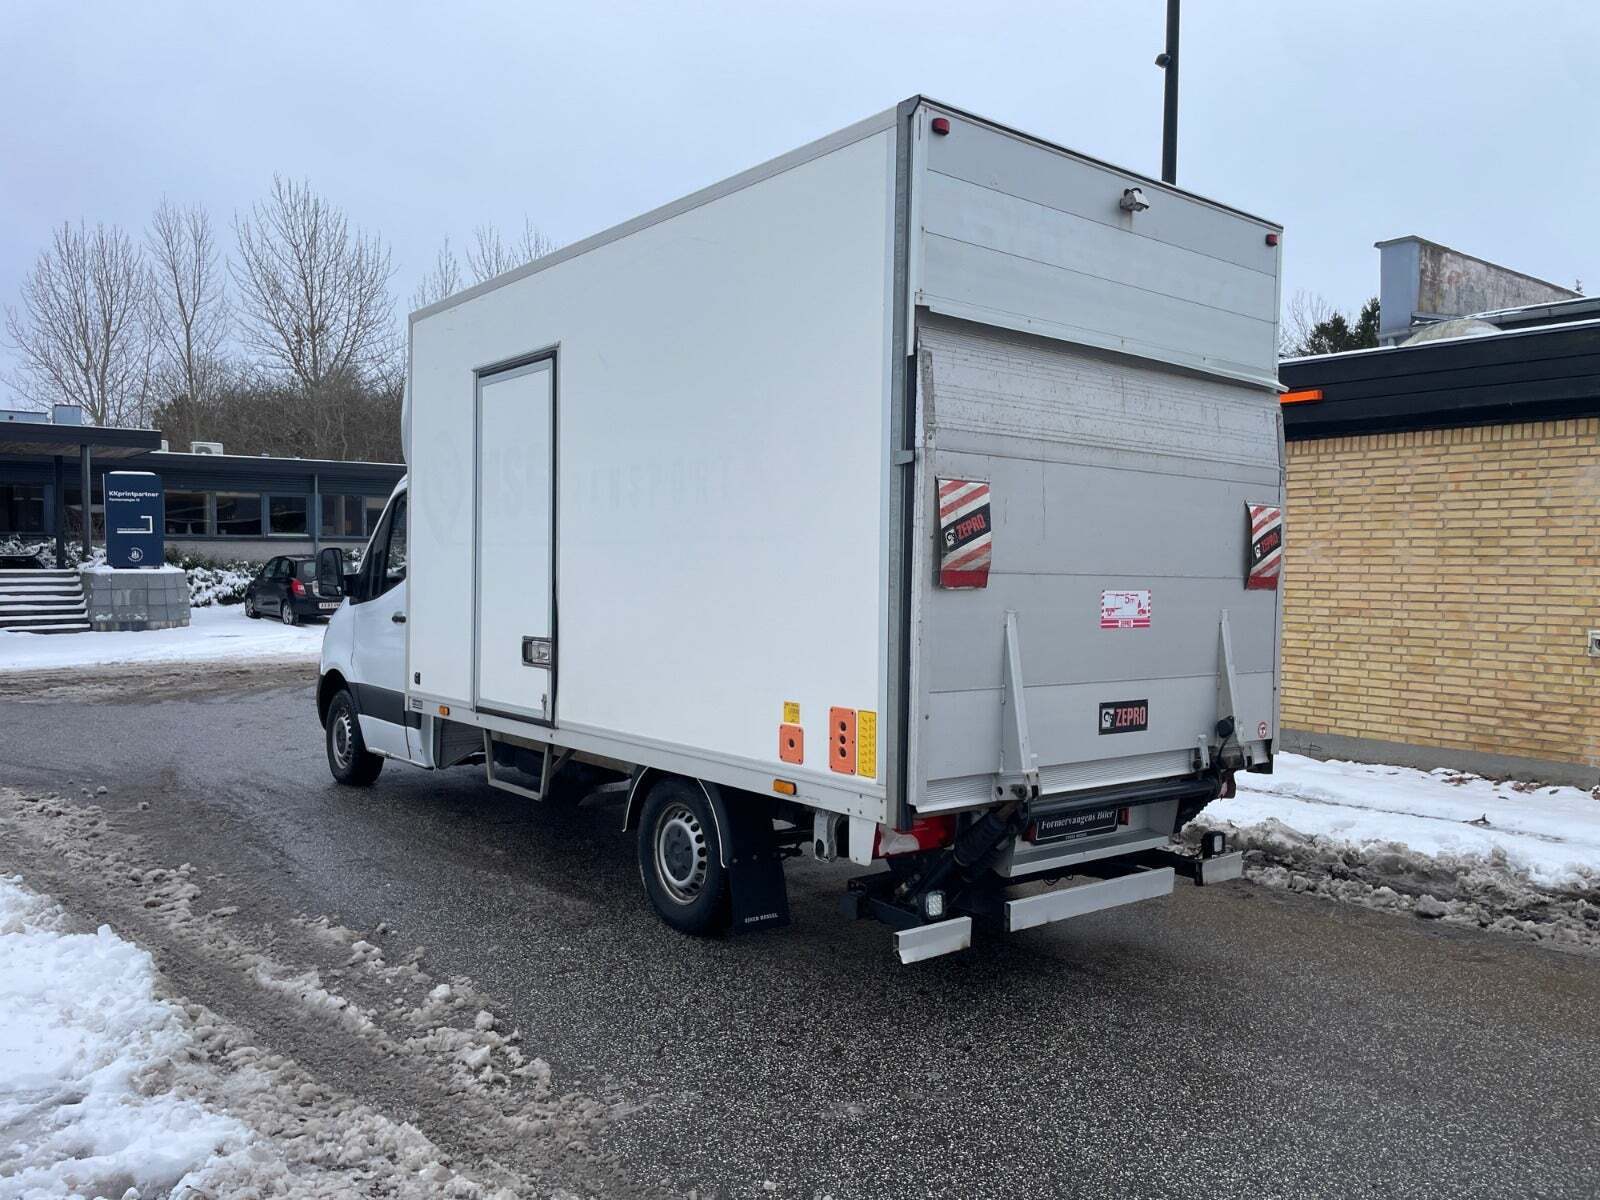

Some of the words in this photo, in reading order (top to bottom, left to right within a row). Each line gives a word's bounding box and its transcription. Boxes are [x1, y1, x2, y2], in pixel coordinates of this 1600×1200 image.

[108, 490, 159, 498] KKprintpartner
[956, 513, 986, 540] ZEPRO
[1115, 706, 1146, 727] ZEPRO
